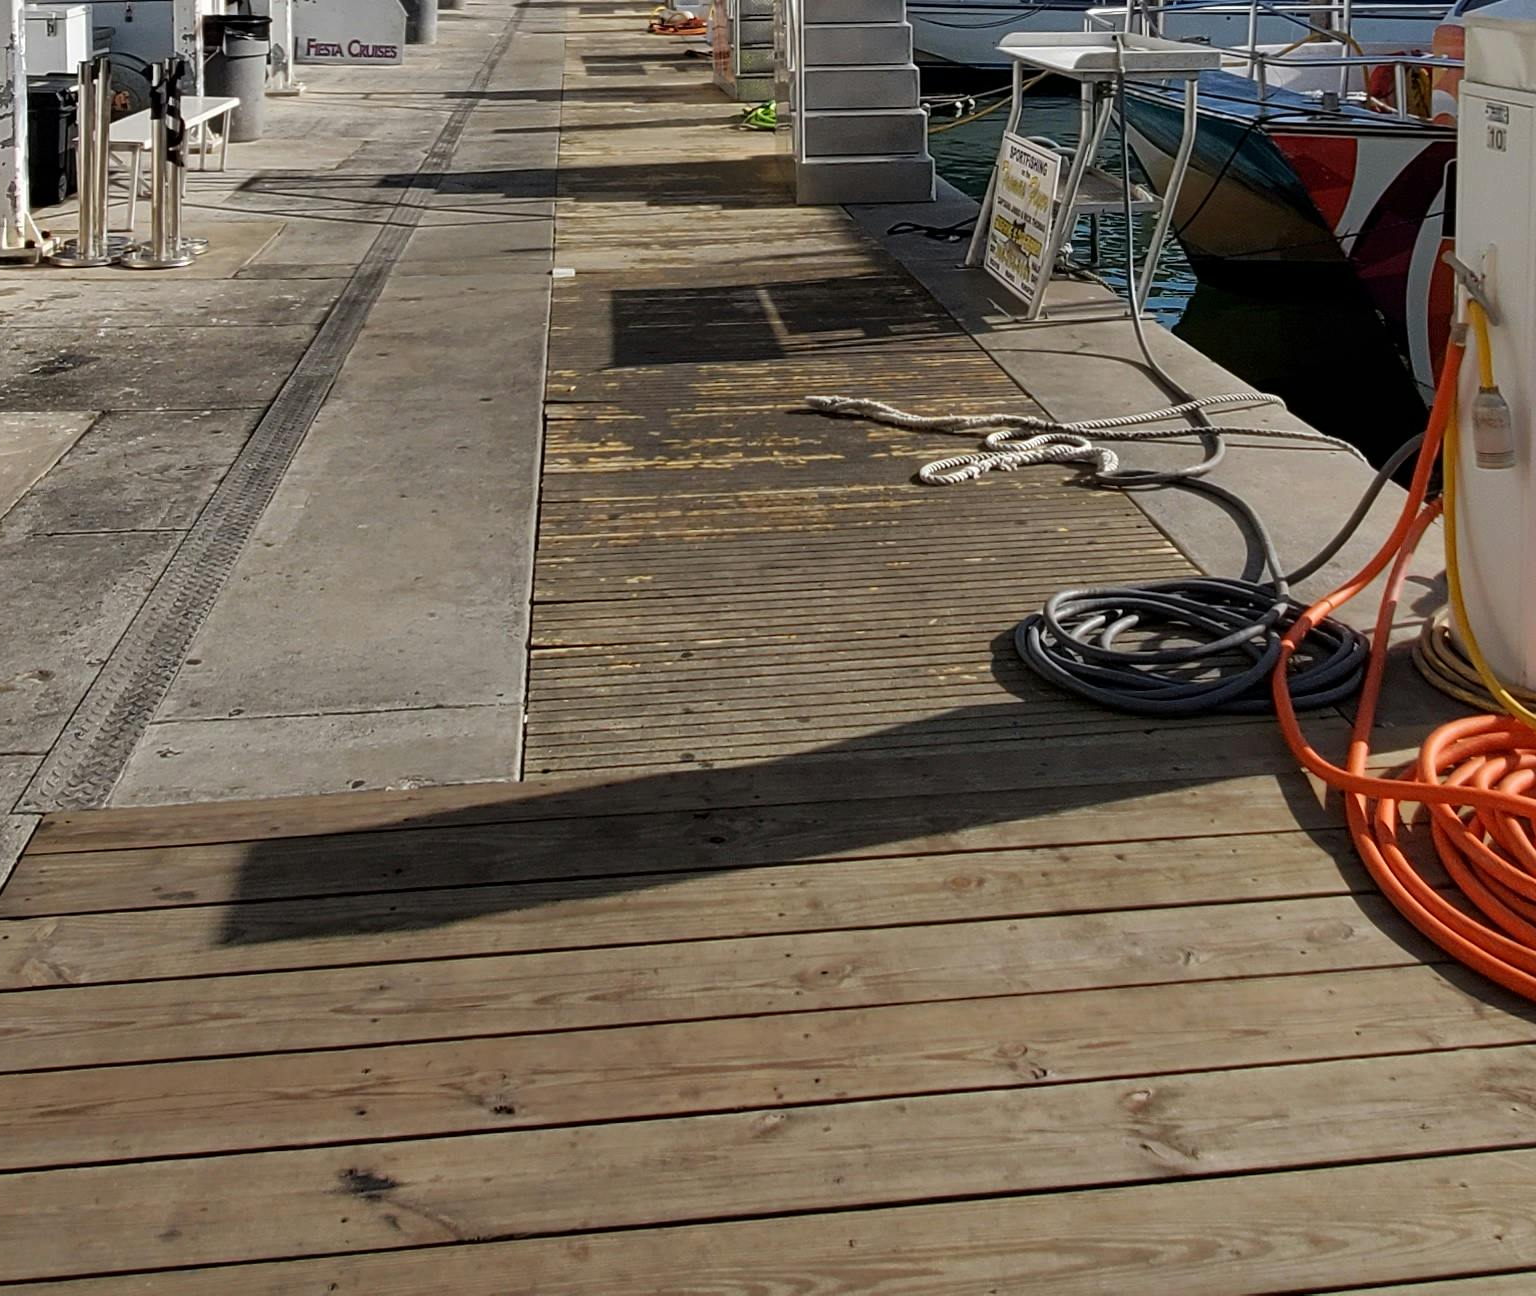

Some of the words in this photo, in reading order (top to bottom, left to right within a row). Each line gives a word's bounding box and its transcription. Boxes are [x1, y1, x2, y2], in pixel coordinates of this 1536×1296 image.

[306, 38, 344, 57] FIESTA
[348, 40, 397, 59] CRUISES
[1489, 128, 1504, 150] 10
[1009, 145, 1049, 177] SPORTFISHING
